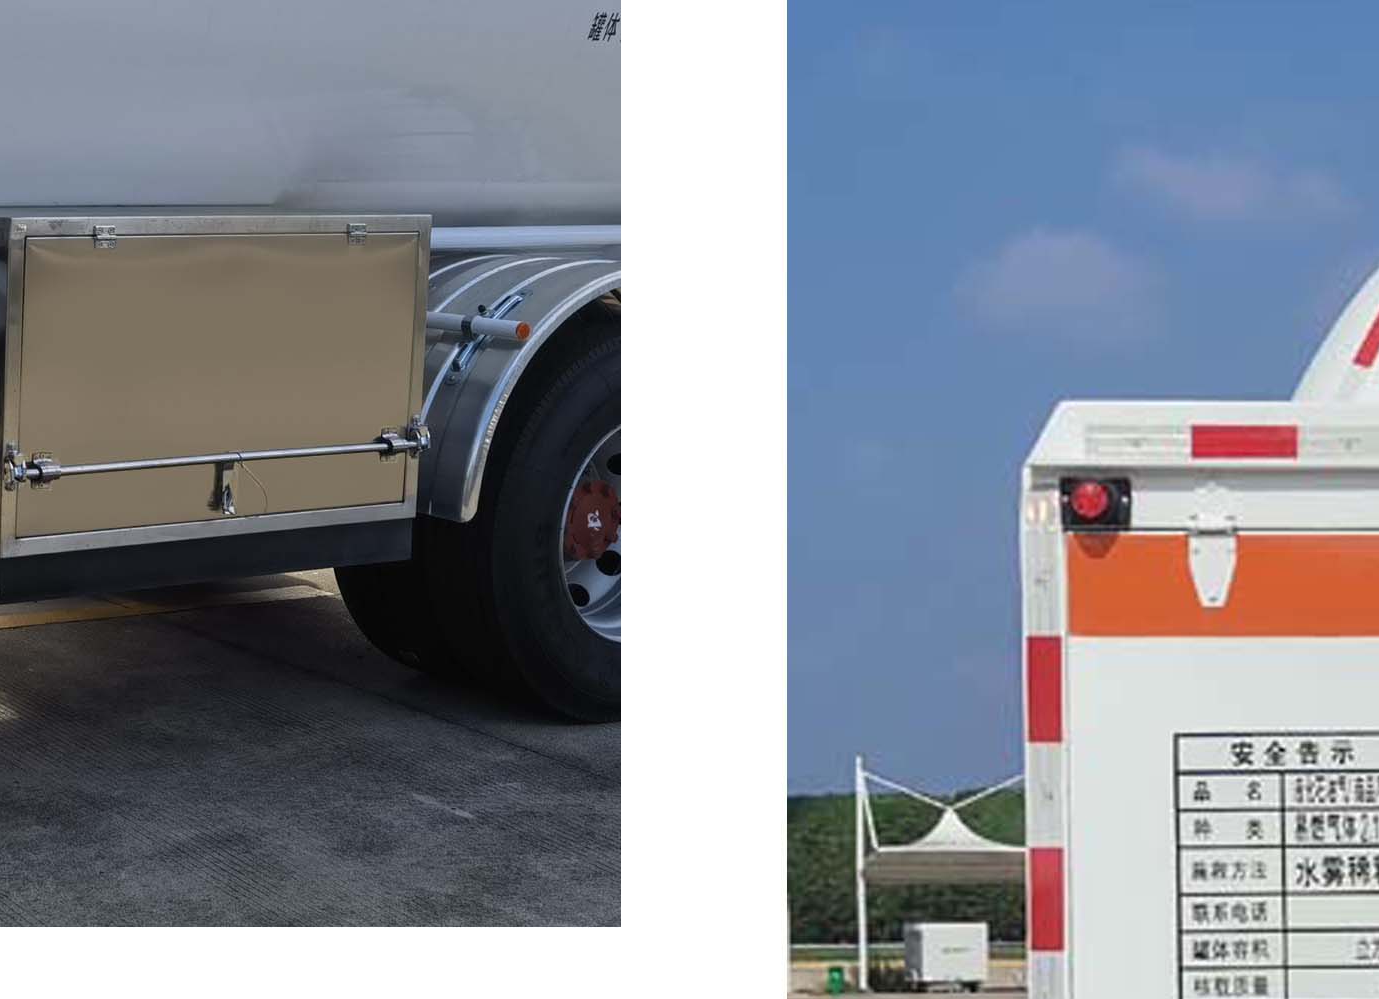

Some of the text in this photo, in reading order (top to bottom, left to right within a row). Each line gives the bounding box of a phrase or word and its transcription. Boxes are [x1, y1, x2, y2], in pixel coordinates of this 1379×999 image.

[1230, 740, 1355, 766] 安全告示
[1191, 901, 1268, 924] 联系电话
[1193, 938, 1271, 961] 罐体容积
